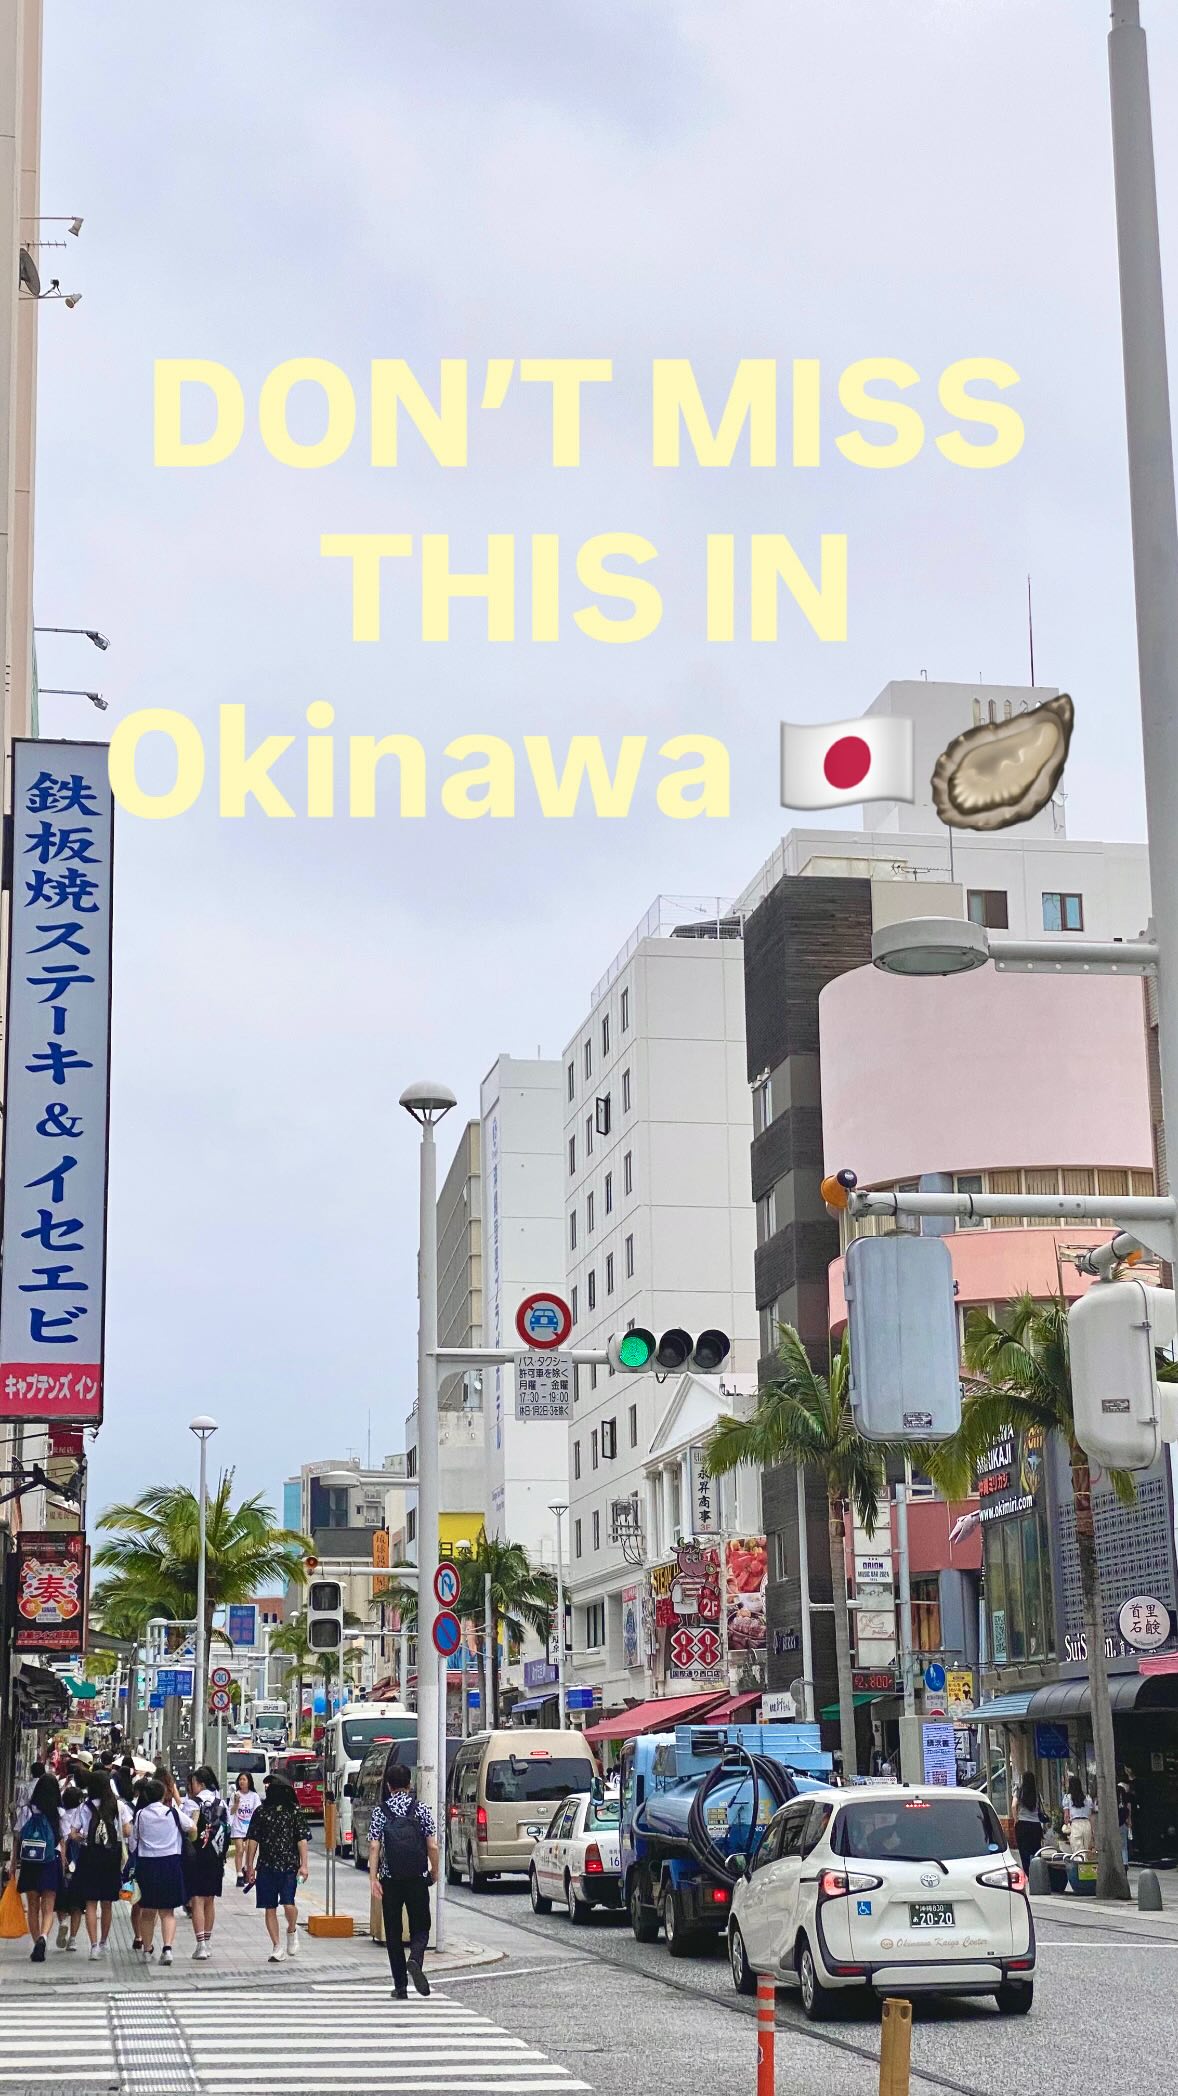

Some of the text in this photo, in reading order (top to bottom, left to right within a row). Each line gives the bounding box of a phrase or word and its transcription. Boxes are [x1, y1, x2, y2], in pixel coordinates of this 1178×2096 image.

[519, 1368, 568, 1378] 許可車を除く
[979, 1494, 1033, 1521] www.okimiri.com
[862, 1562, 884, 1570] ORION
[28, 1573, 72, 1605] 奏
[702, 1599, 718, 1617] 2F
[1129, 1603, 1158, 1619] 首里
